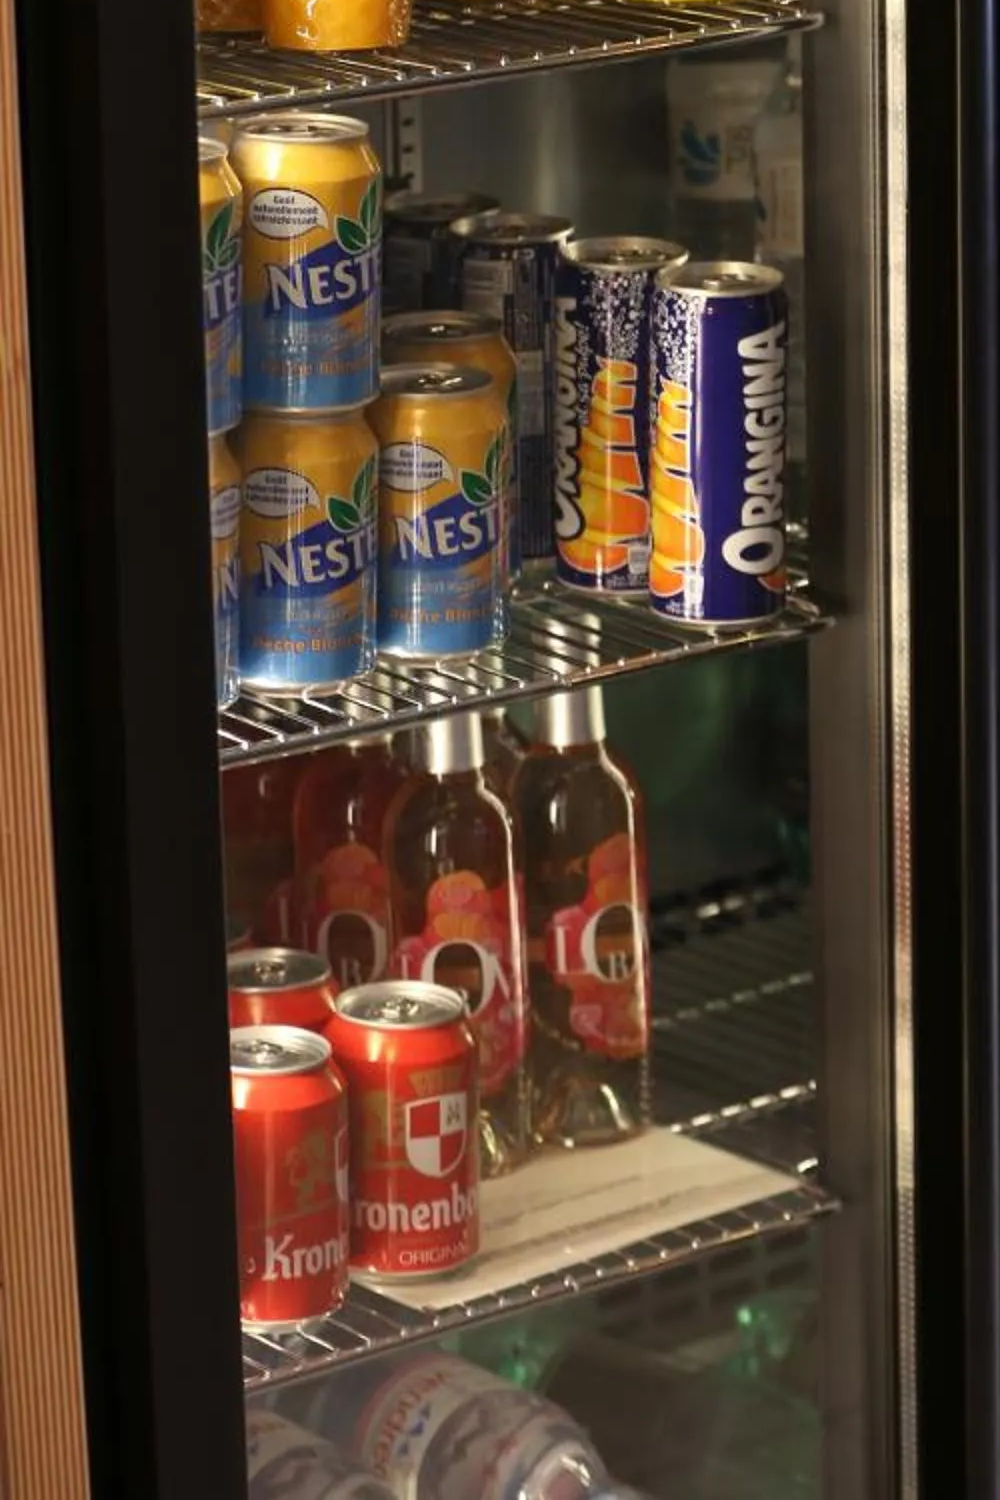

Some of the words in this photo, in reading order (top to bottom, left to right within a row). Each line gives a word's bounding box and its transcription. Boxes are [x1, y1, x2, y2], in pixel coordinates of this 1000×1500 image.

[722, 322, 787, 577] ORANGINA
[355, 1181, 476, 1233] ronenbo
[399, 1240, 468, 1266] ORIGINA
